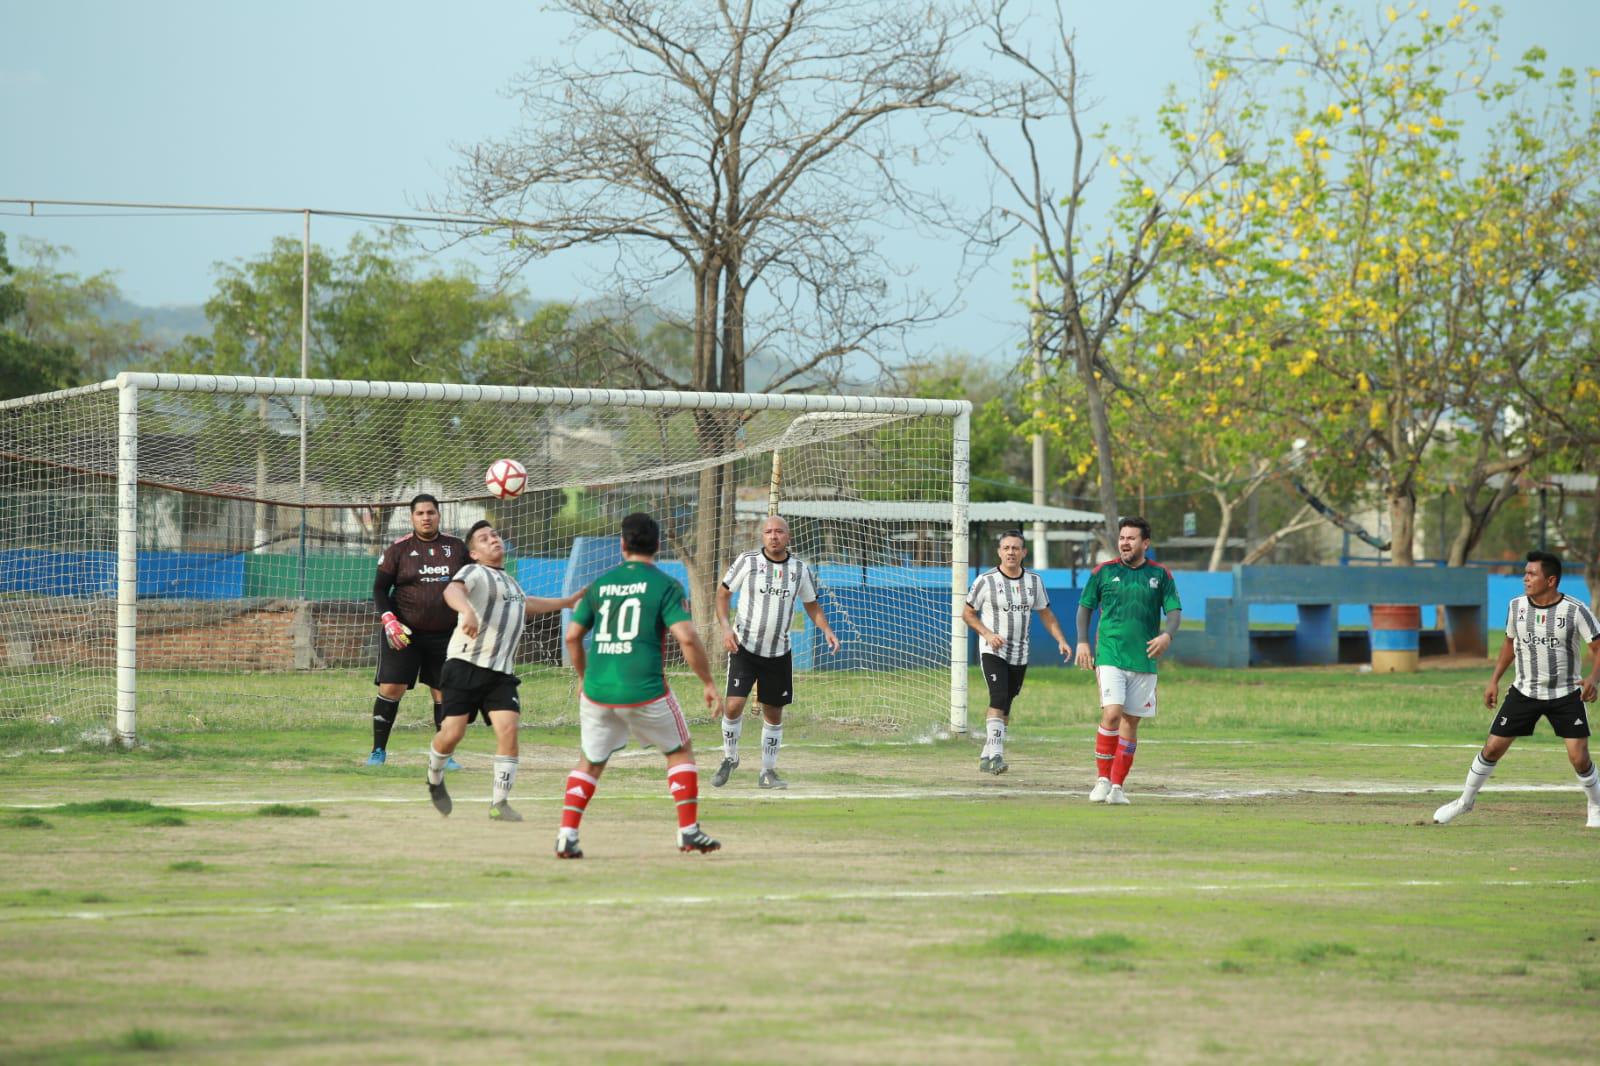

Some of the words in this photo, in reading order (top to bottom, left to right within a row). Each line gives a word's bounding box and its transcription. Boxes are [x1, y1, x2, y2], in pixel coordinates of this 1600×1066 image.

[419, 565, 449, 575] Jeep
[599, 582, 647, 597] PINZON
[760, 583, 791, 599] Jeep
[1003, 601, 1030, 613] Jeep
[595, 597, 641, 642] 10
[597, 641, 633, 655] IMSS
[1522, 633, 1560, 648] Jeep
